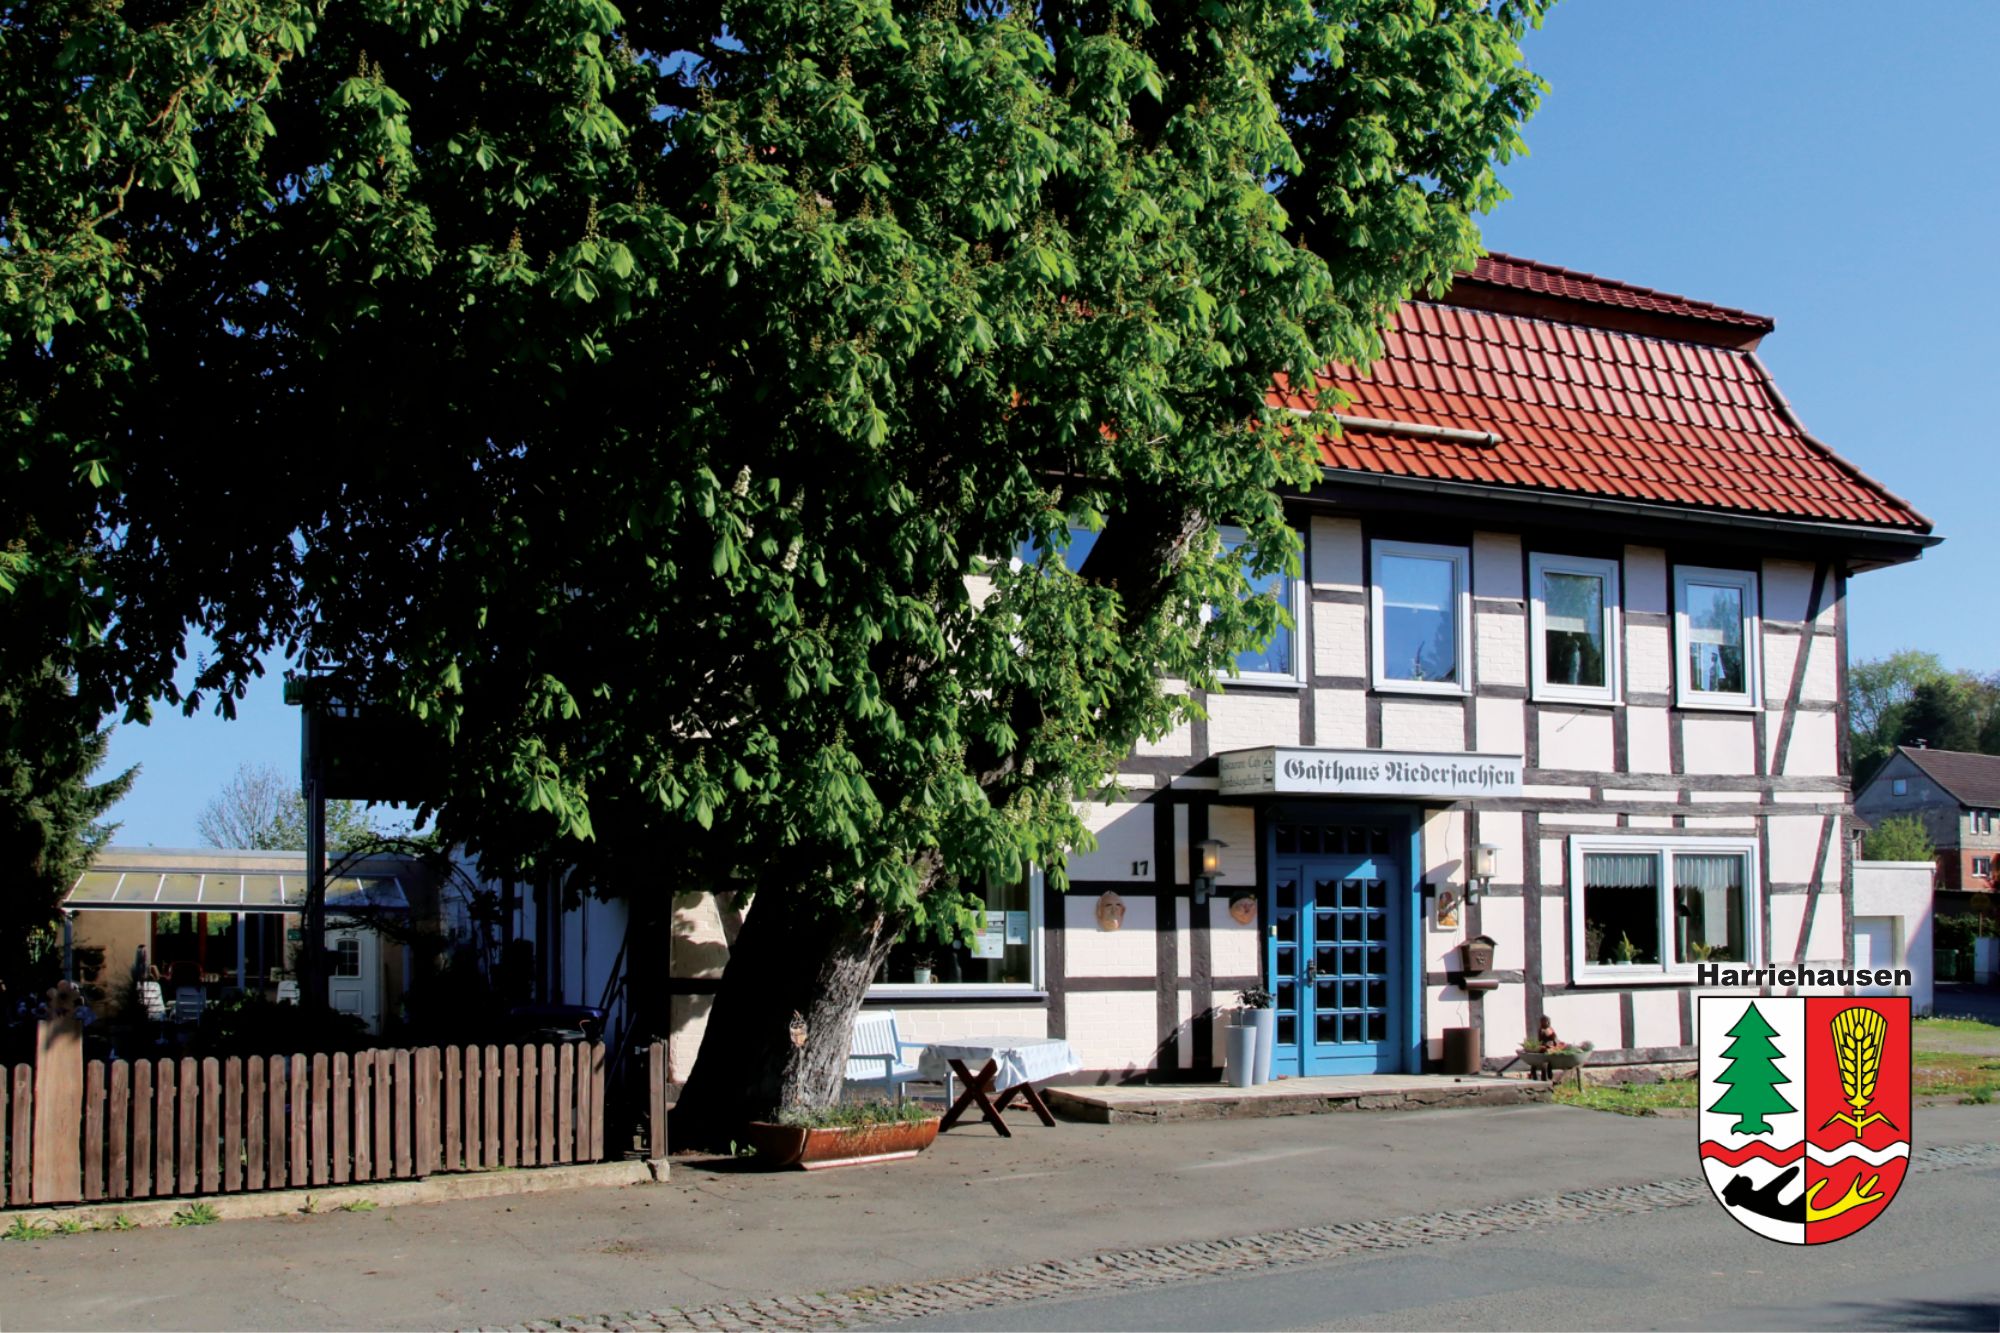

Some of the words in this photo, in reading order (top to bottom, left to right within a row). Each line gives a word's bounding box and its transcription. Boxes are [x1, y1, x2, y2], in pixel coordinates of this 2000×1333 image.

[1284, 758, 1379, 785] Gasthaus
[1385, 761, 1515, 790] Niedersachsen
[1131, 860, 1149, 876] 17
